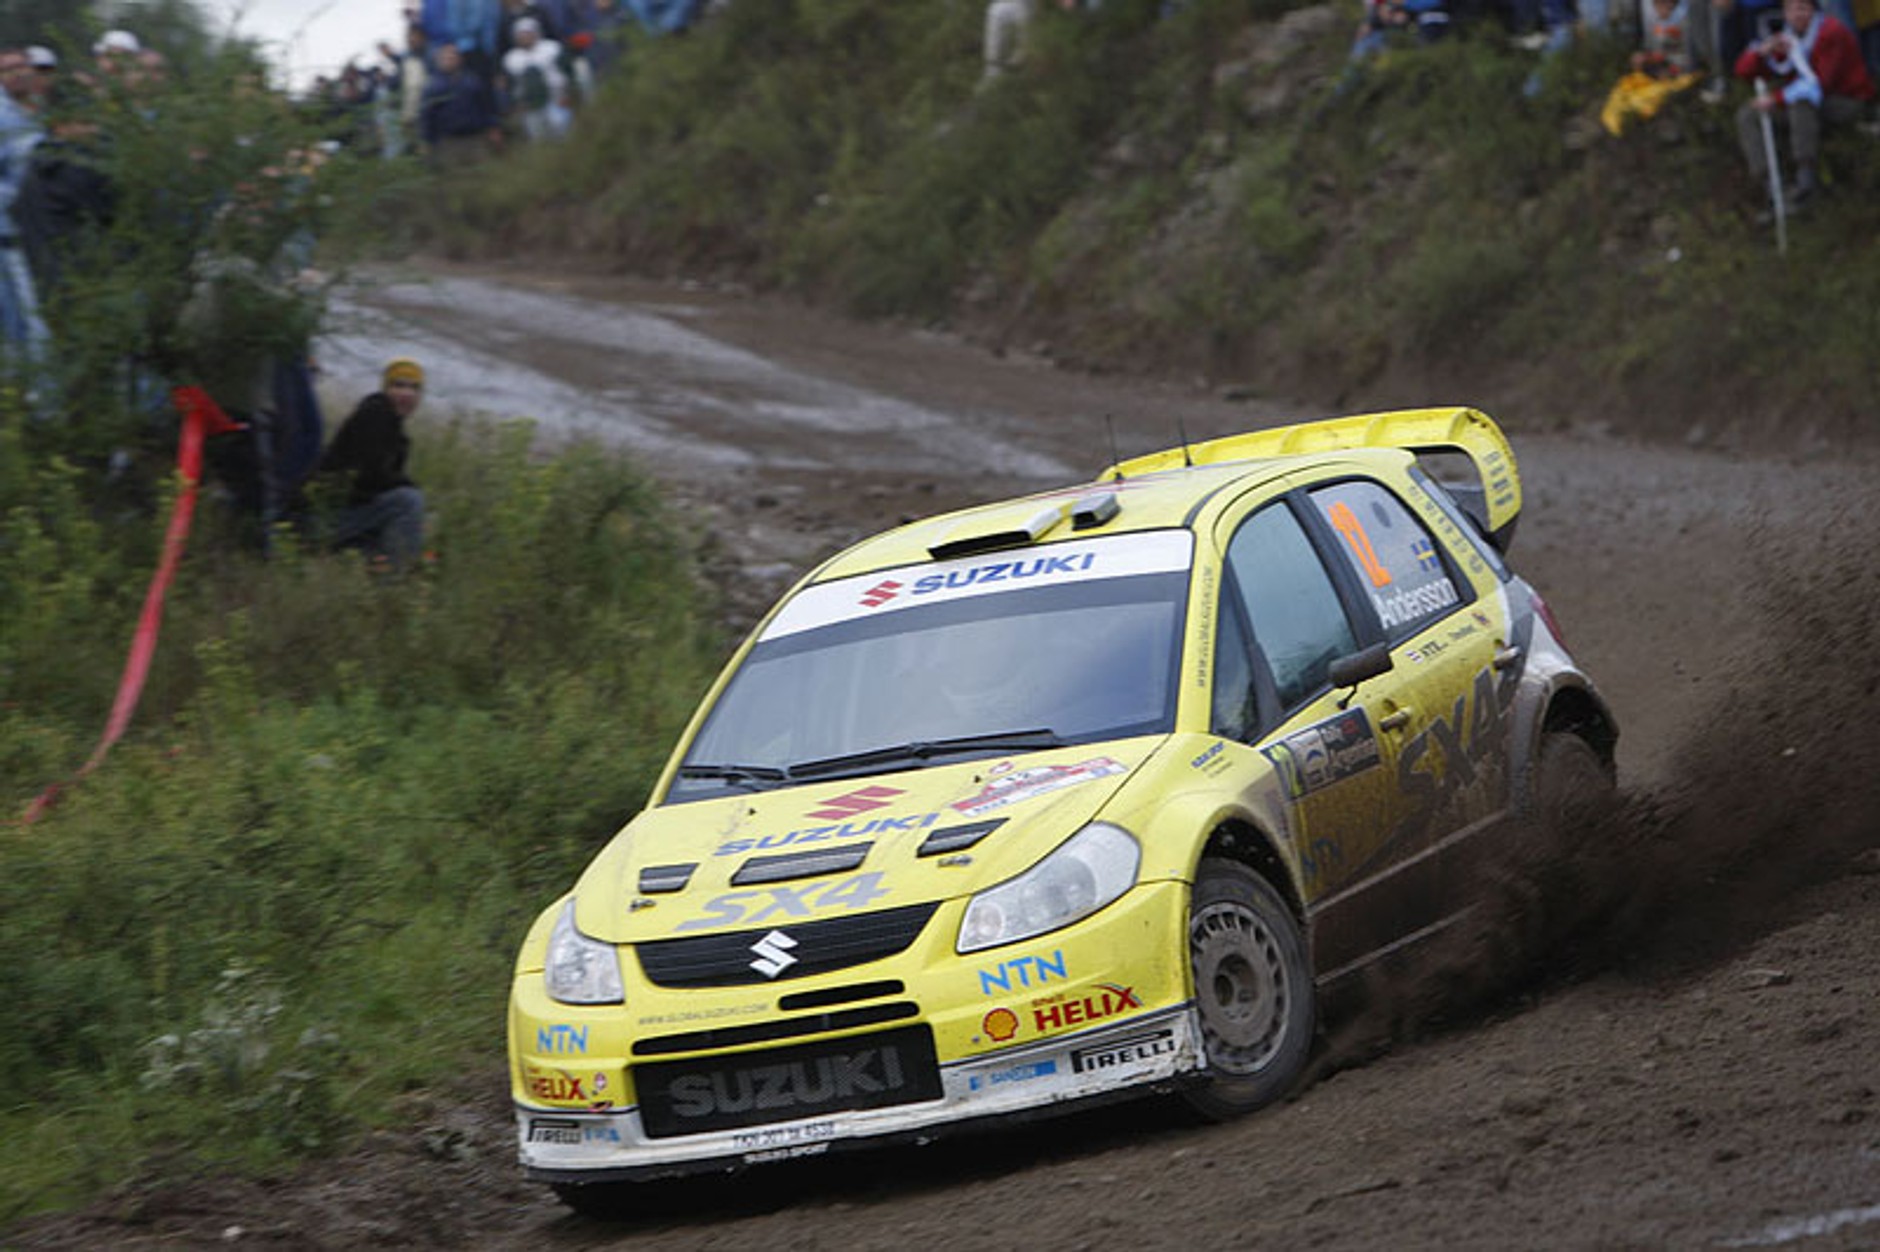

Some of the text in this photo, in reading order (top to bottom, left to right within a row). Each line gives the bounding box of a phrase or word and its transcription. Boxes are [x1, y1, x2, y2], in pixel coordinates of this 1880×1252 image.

[1327, 501, 1392, 588] 12
[911, 552, 1096, 596] SUZUKI
[1371, 576, 1460, 630] Andersson
[713, 812, 940, 857] SUZUKI
[674, 871, 893, 931] SX4
[978, 949, 1068, 996] NTN
[1032, 984, 1142, 1032] HELIX
[536, 1024, 588, 1054] NTN
[1069, 1029, 1176, 1075] PIRELLI
[528, 1074, 588, 1101] HELIX
[668, 1045, 904, 1119] SUZUKI
[526, 1118, 582, 1145] PIRELLI
